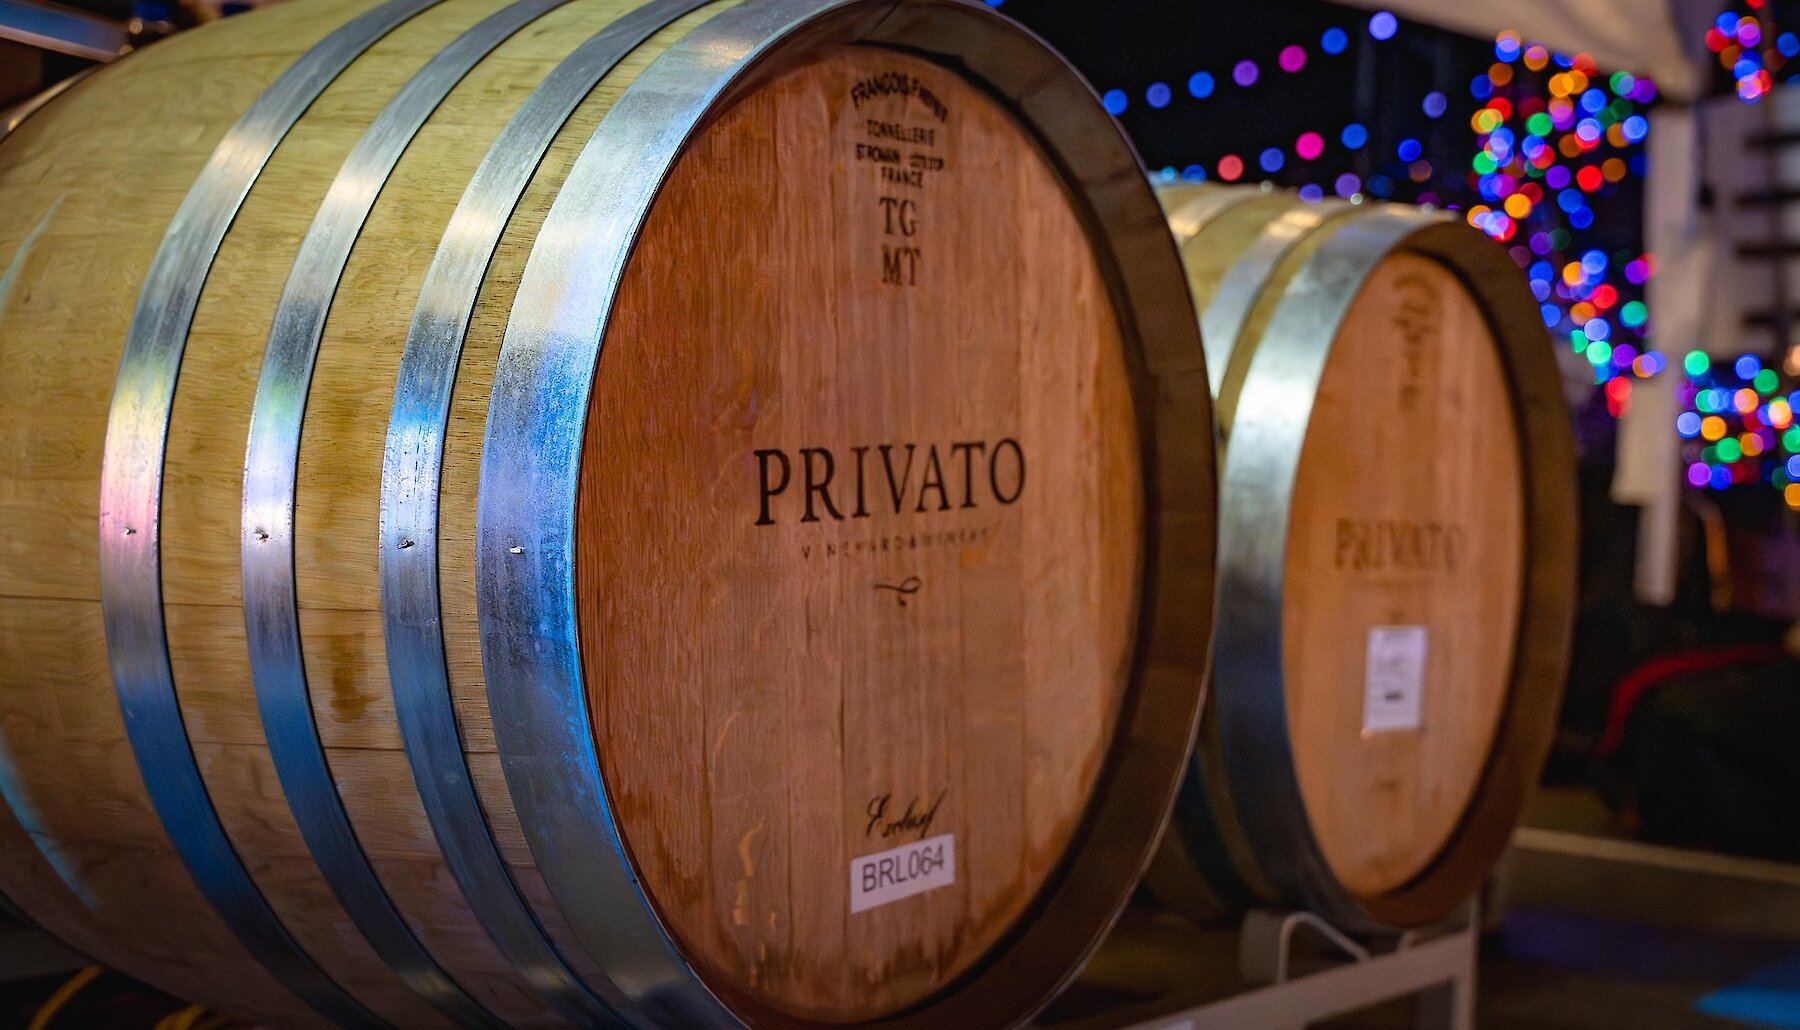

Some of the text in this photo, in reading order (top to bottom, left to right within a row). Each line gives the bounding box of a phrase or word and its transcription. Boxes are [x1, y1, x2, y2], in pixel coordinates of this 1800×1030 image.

[879, 196, 916, 236] TG
[881, 245, 921, 287] MT
[753, 437, 1027, 527] PRIVATO
[862, 844, 944, 893] BRL064
